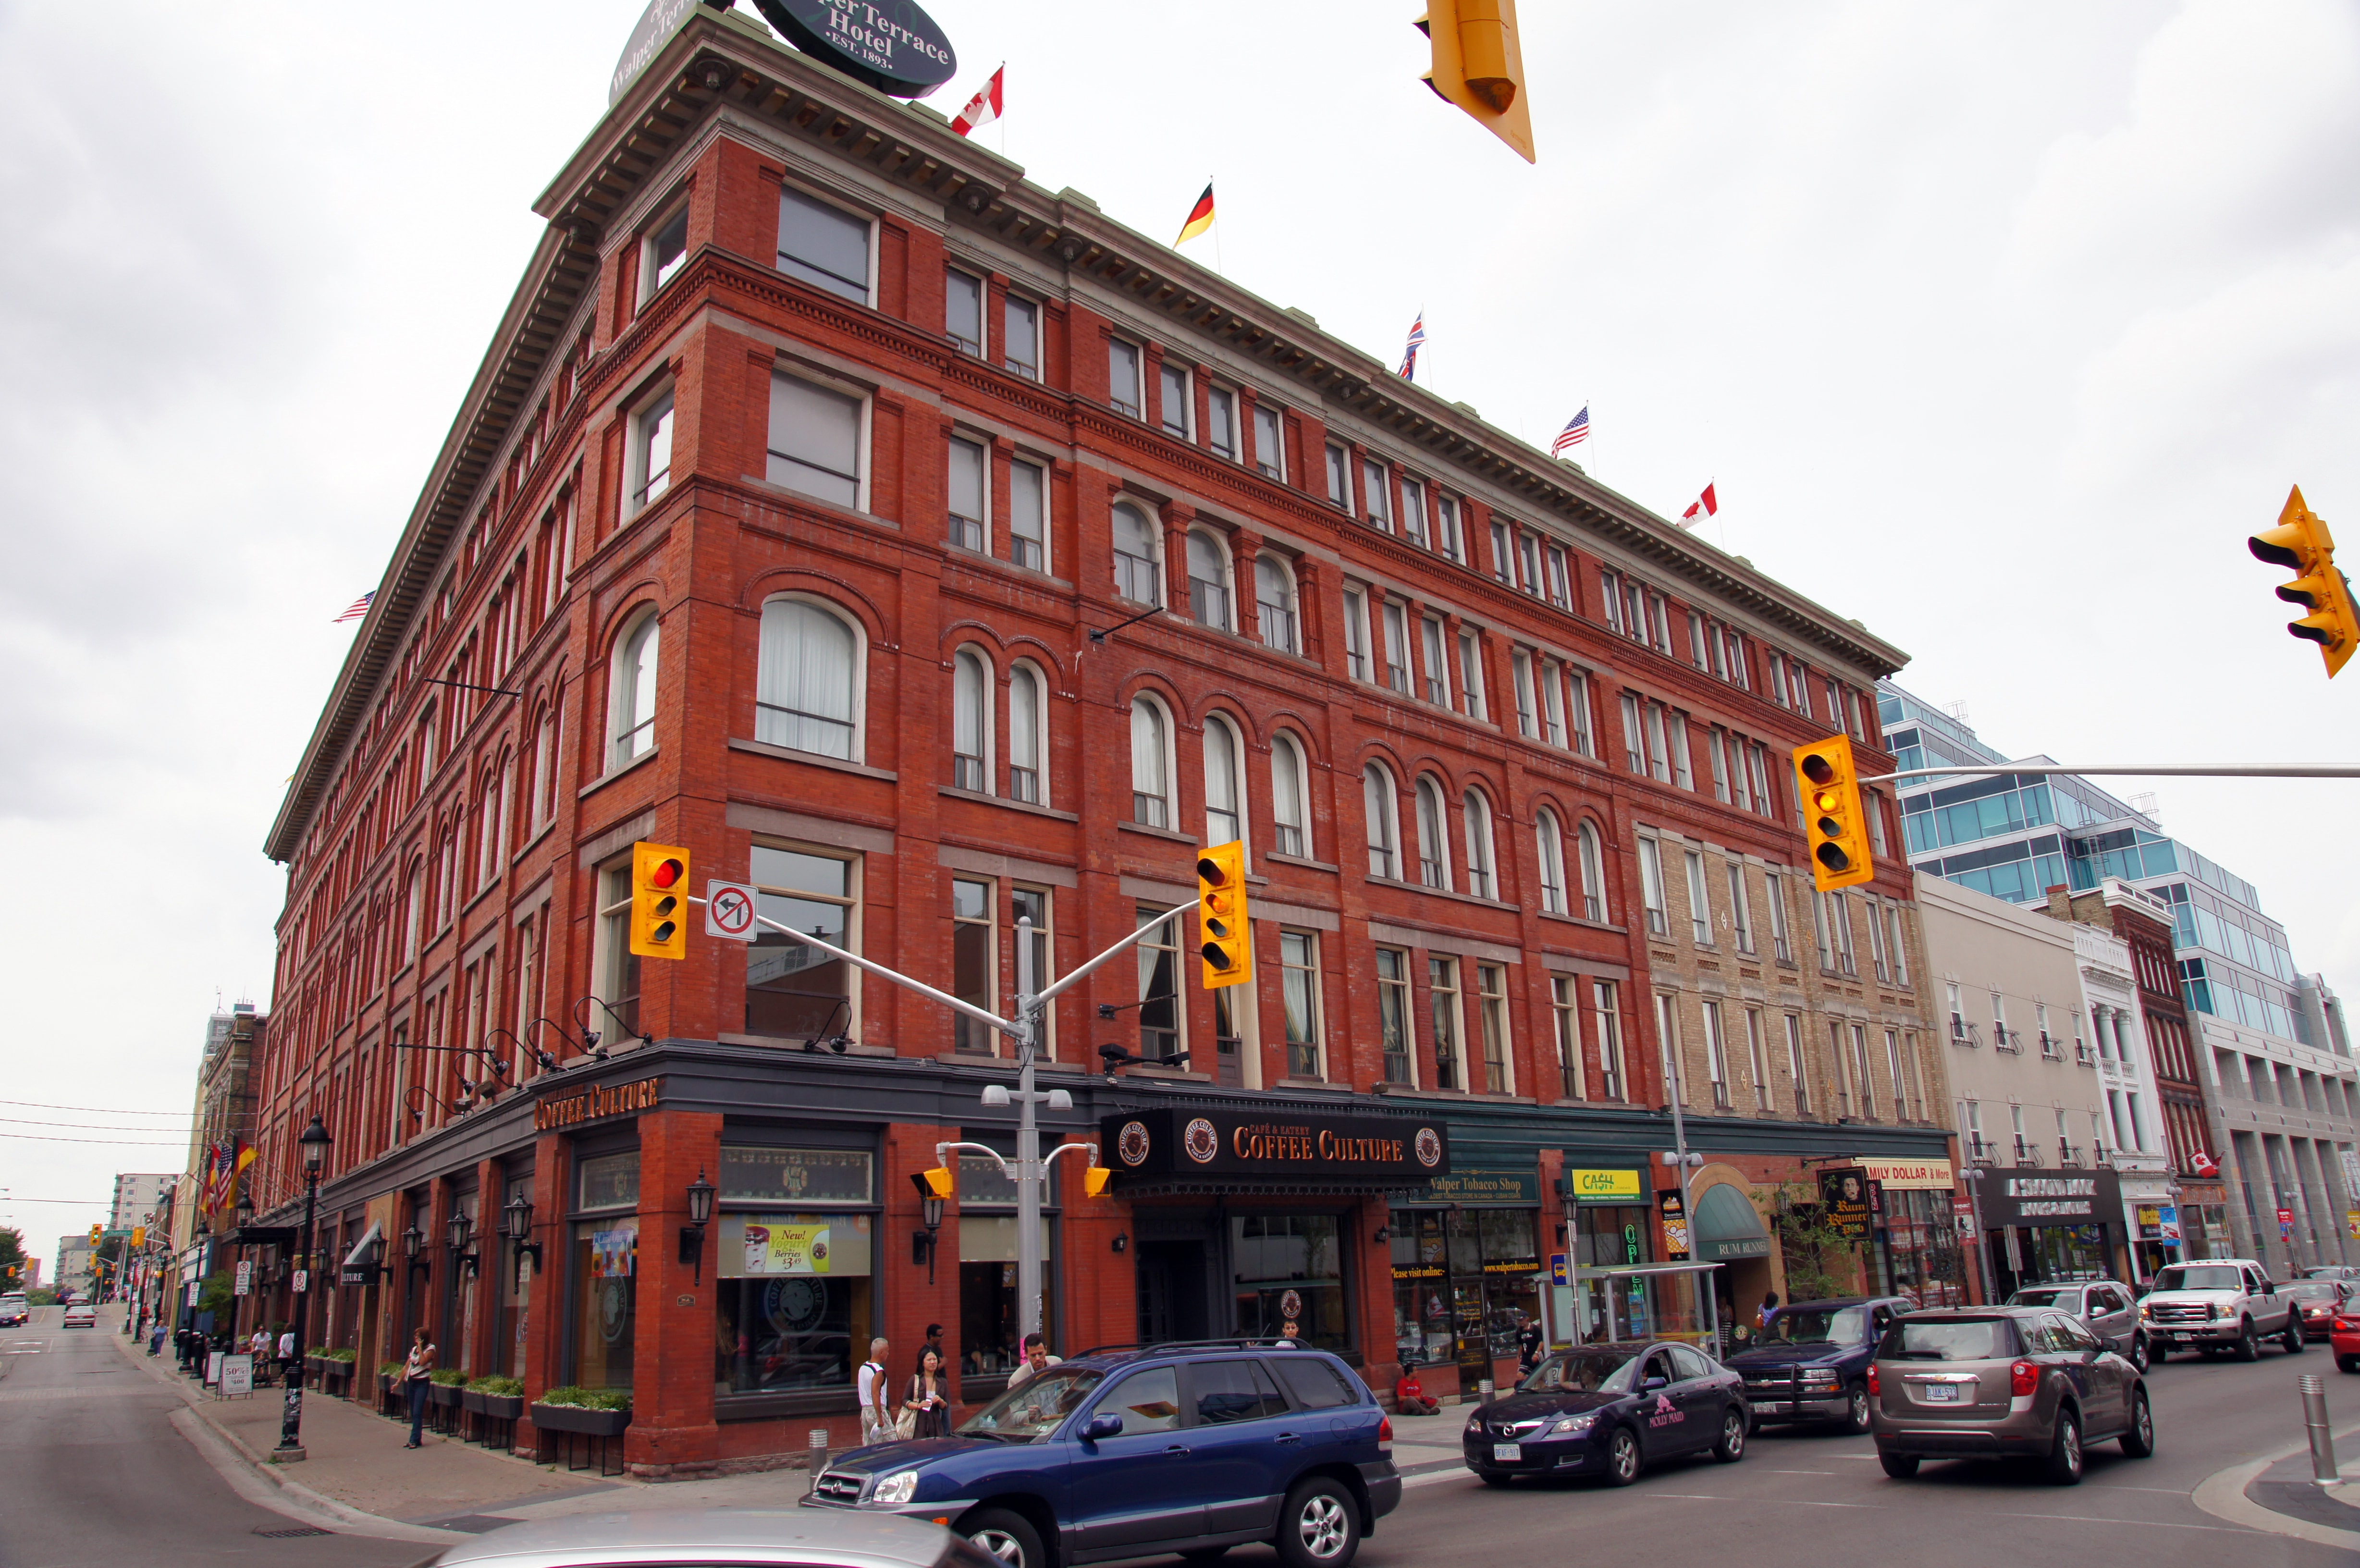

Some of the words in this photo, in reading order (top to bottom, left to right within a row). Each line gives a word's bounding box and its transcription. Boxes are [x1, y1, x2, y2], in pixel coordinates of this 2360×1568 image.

[828, 7, 892, 58] Hotel
[862, 2, 949, 64] Terrace
[832, 32, 859, 54] EST.
[614, 30, 657, 92] Walper
[534, 1096, 585, 1130] COFFEE
[589, 1078, 658, 1118] CULTURE
[1121, 1125, 1131, 1149] COFFEE
[1132, 1124, 1147, 1147] CULTURE
[1187, 1122, 1199, 1144] COFFEE
[1200, 1121, 1216, 1145] CULTURE
[1250, 1123, 1270, 1134] CAFÉ
[1272, 1126, 1278, 1134] &
[1280, 1126, 1310, 1135] EATERY
[1233, 1127, 1313, 1160] COFFEE
[1319, 1130, 1403, 1162] CULTURE
[1426, 1131, 1438, 1151] CULTURE
[1867, 1167, 1889, 1179] MILY
[1893, 1167, 1927, 1179] DOLLAR
[1930, 1168, 1934, 1177] &
[1936, 1169, 1949, 1179] More
[1462, 1177, 1498, 1190] Tobacco
[1500, 1177, 1521, 1193] Shop
[1868, 1183, 1879, 1211] OPEN
[1837, 1200, 1866, 1212] Rum
[1826, 1213, 1868, 1226] Runner
[781, 1230, 806, 1240] New!
[770, 1236, 808, 1252] Yogurt
[1718, 1243, 1740, 1255] RUM
[774, 1250, 801, 1258] Berries
[783, 1257, 801, 1269] $3.49
[1484, 1261, 1539, 1274] www.walpertobacco.com
[1409, 1267, 1421, 1277] visit
[226, 1367, 246, 1375] 50%
[1945, 1388, 1957, 1396] 533
[1649, 1414, 1668, 1428] MOLLY
[1669, 1411, 1684, 1423] MAID
